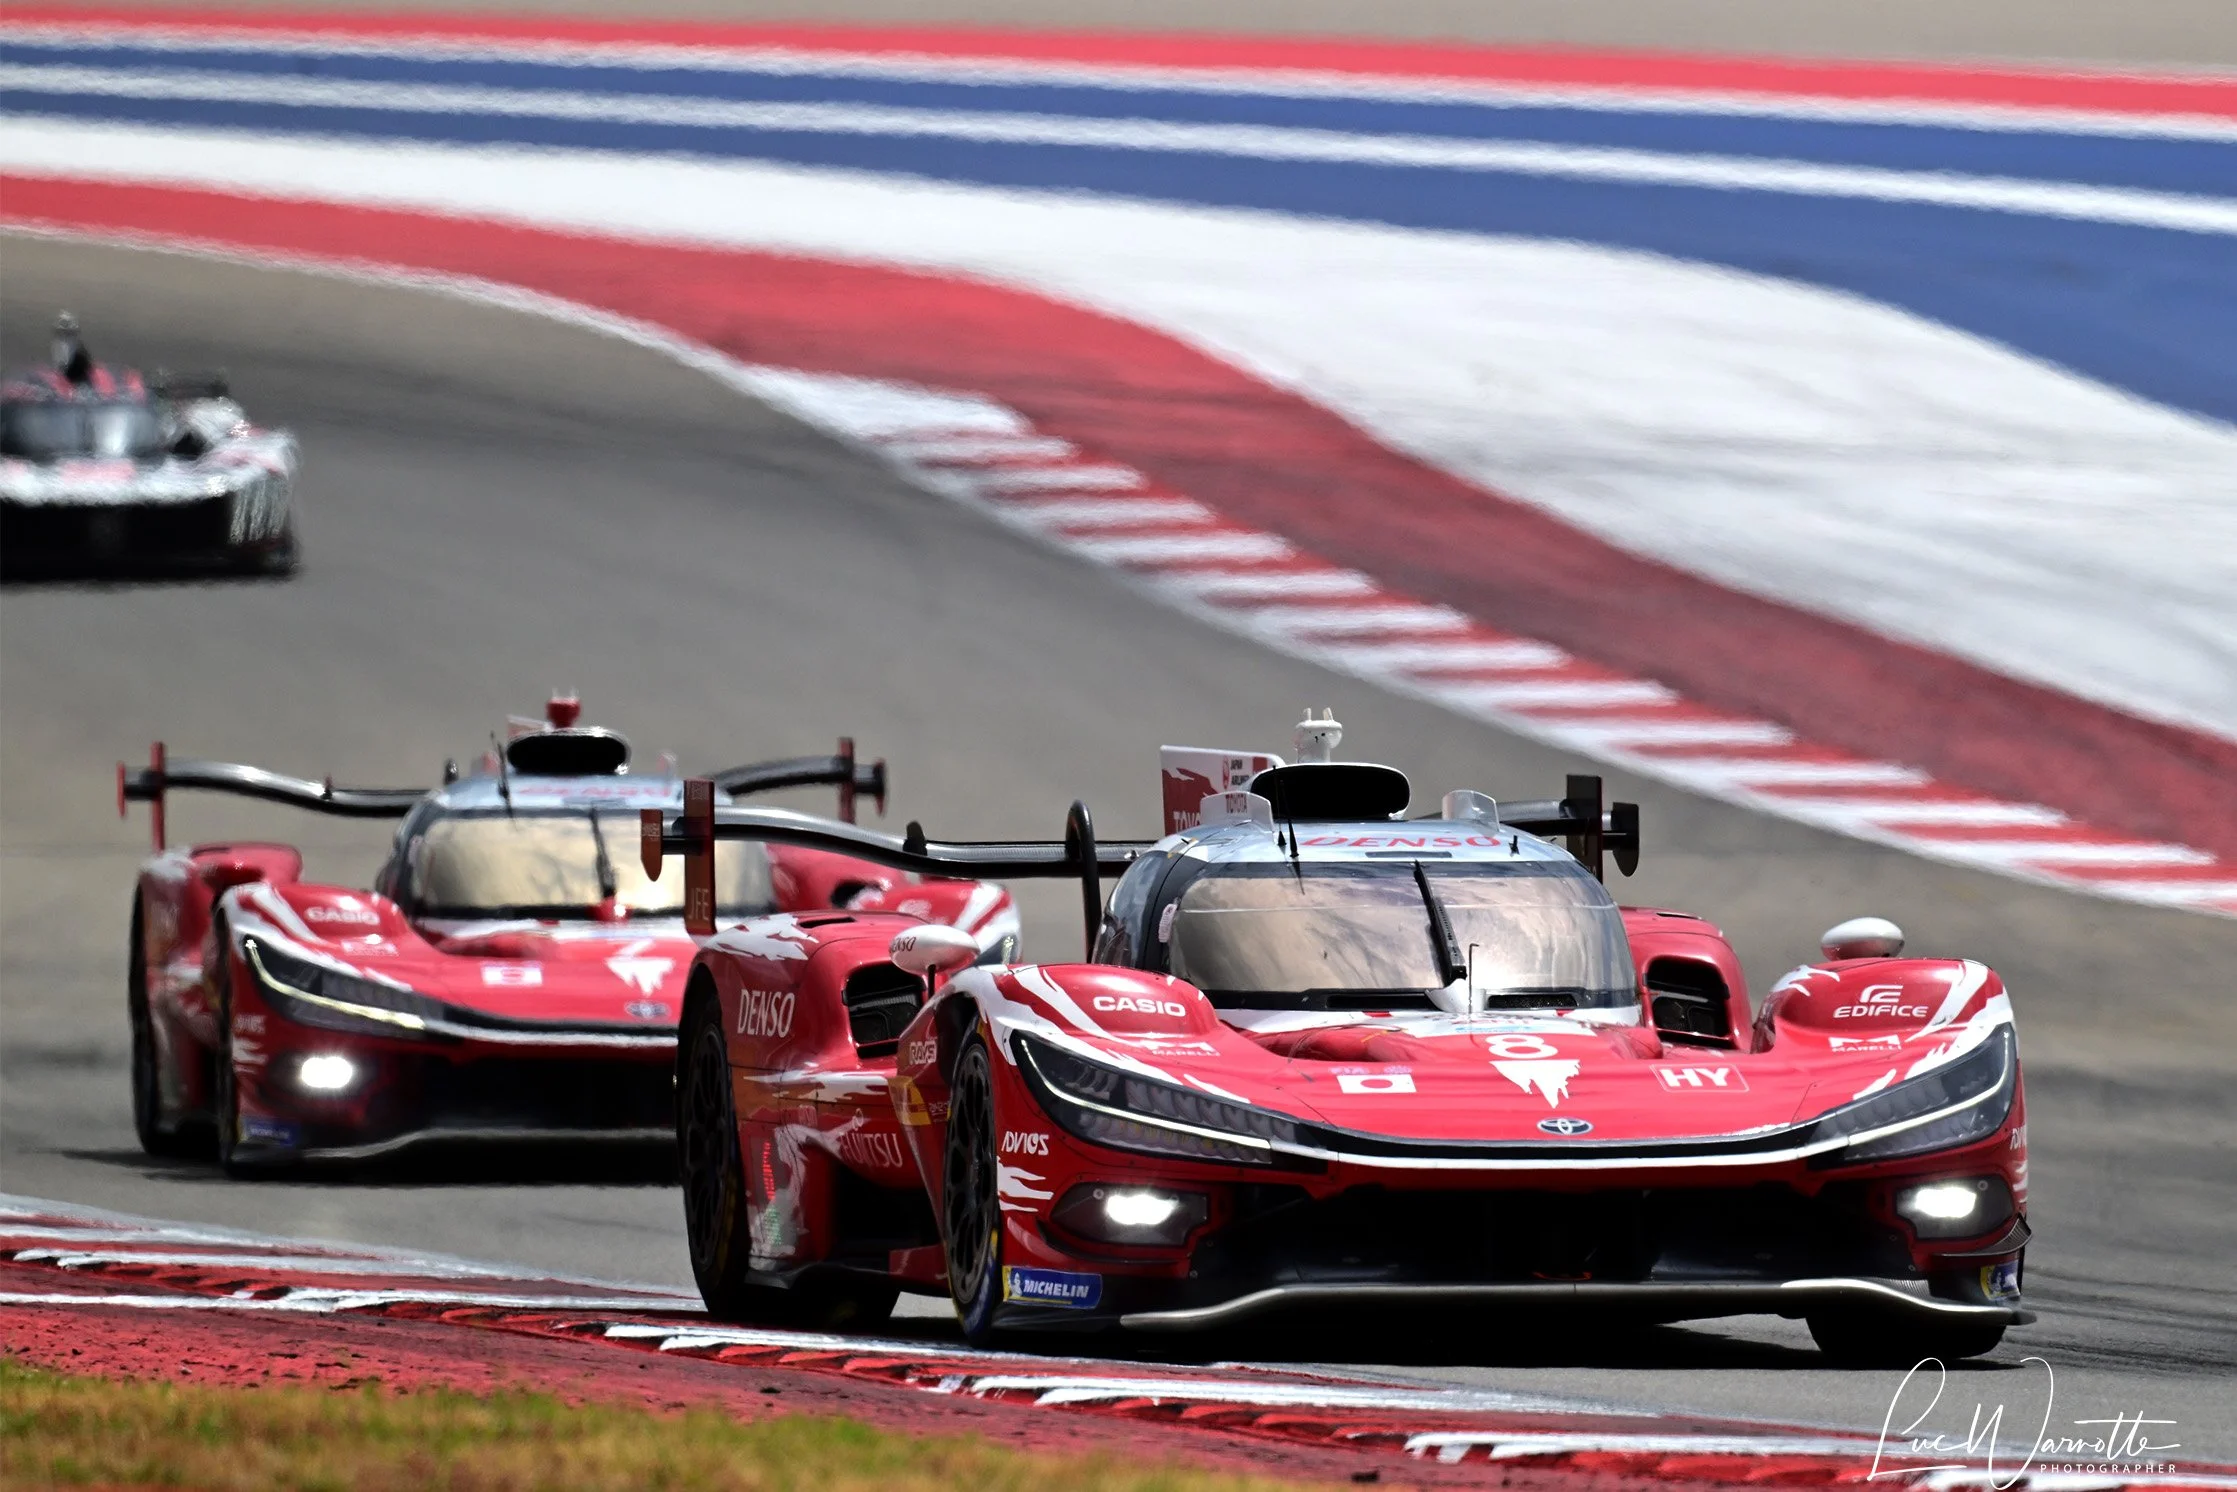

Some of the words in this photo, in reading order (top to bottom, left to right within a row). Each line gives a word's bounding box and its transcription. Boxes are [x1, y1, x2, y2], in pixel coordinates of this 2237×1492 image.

[1300, 836, 1500, 848] DENSO
[688, 887, 709, 920] JFE
[737, 988, 796, 1038] DENSO
[1093, 996, 1187, 1017] CASIO
[1833, 1005, 1930, 1018] EDIFICE
[1485, 1034, 1559, 1059] 8
[1831, 1044, 1902, 1053] MARELLI
[1659, 1067, 1730, 1087] HY
[1023, 1279, 1090, 1298] MICHELIN
